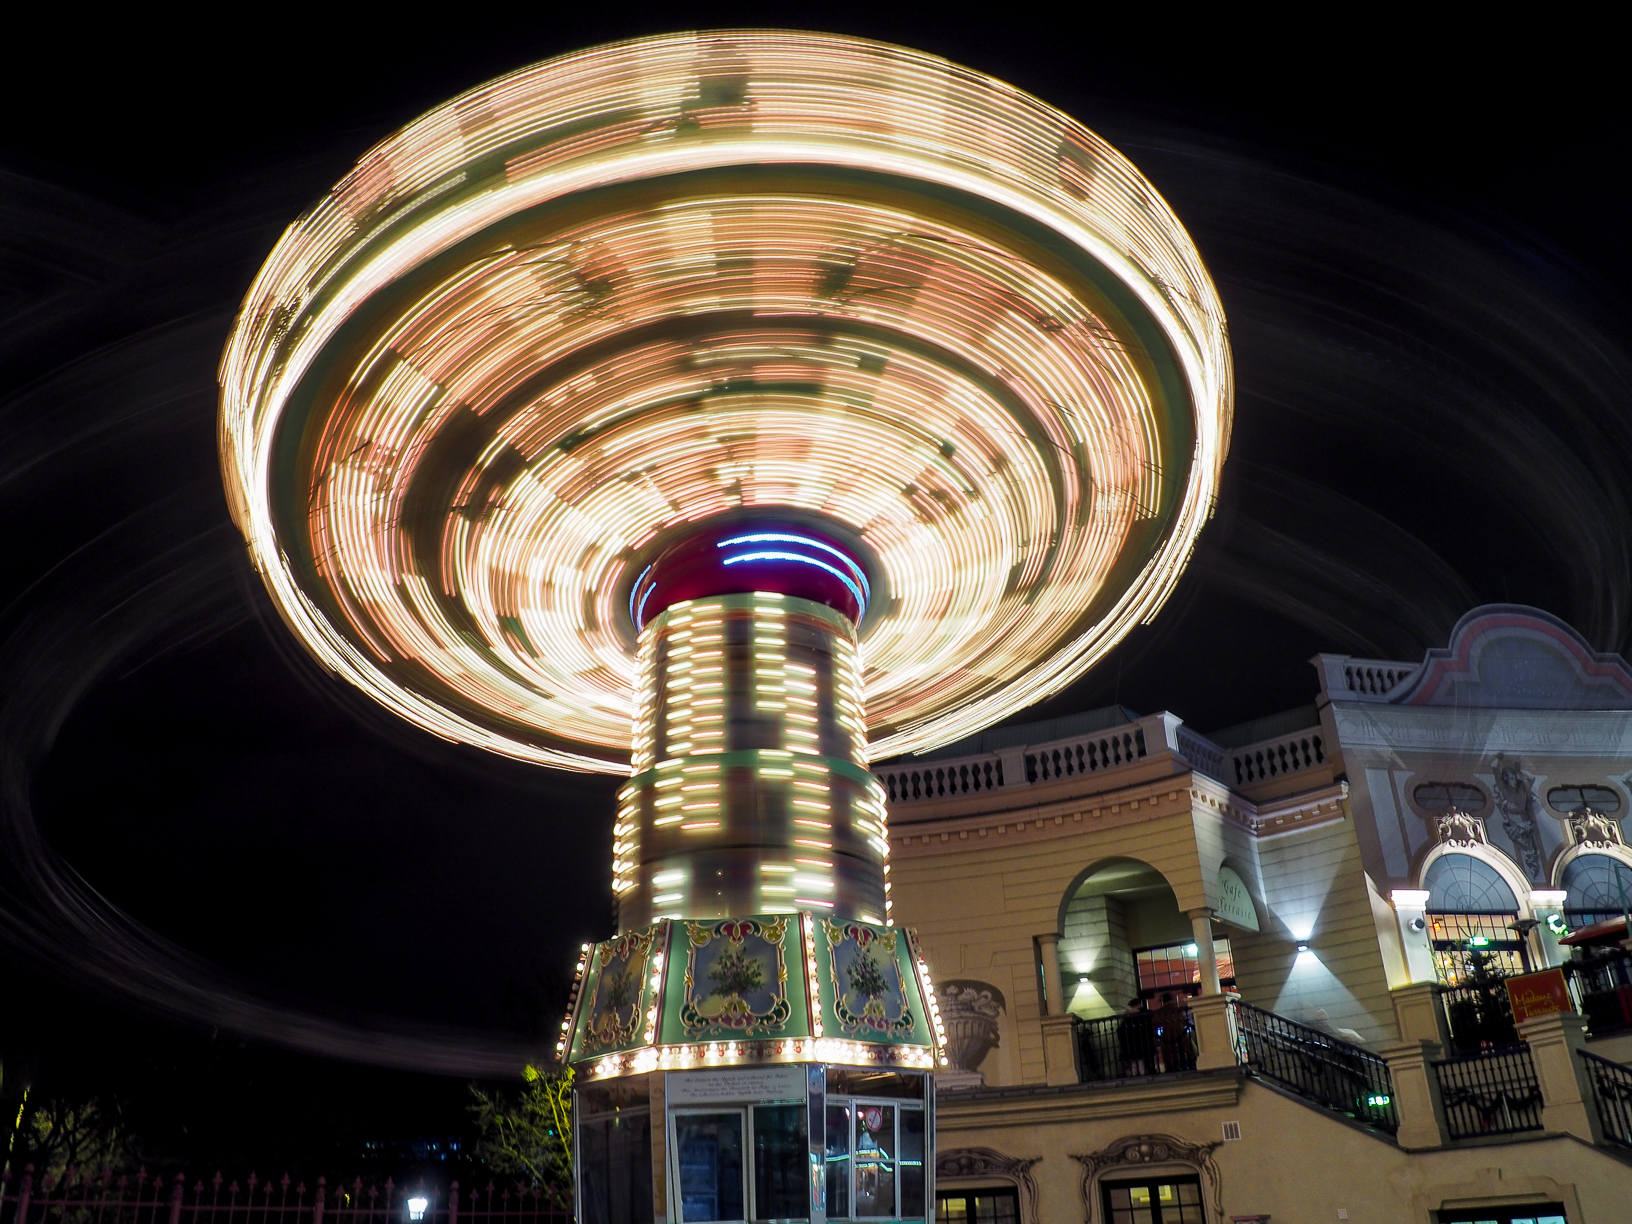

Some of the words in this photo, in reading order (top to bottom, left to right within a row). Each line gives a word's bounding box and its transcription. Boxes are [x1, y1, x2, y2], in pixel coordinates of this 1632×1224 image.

[1218, 895, 1251, 920] Terrasse
[1514, 990, 1552, 1006] Madame
[1519, 1000, 1561, 1017] Tussauds
